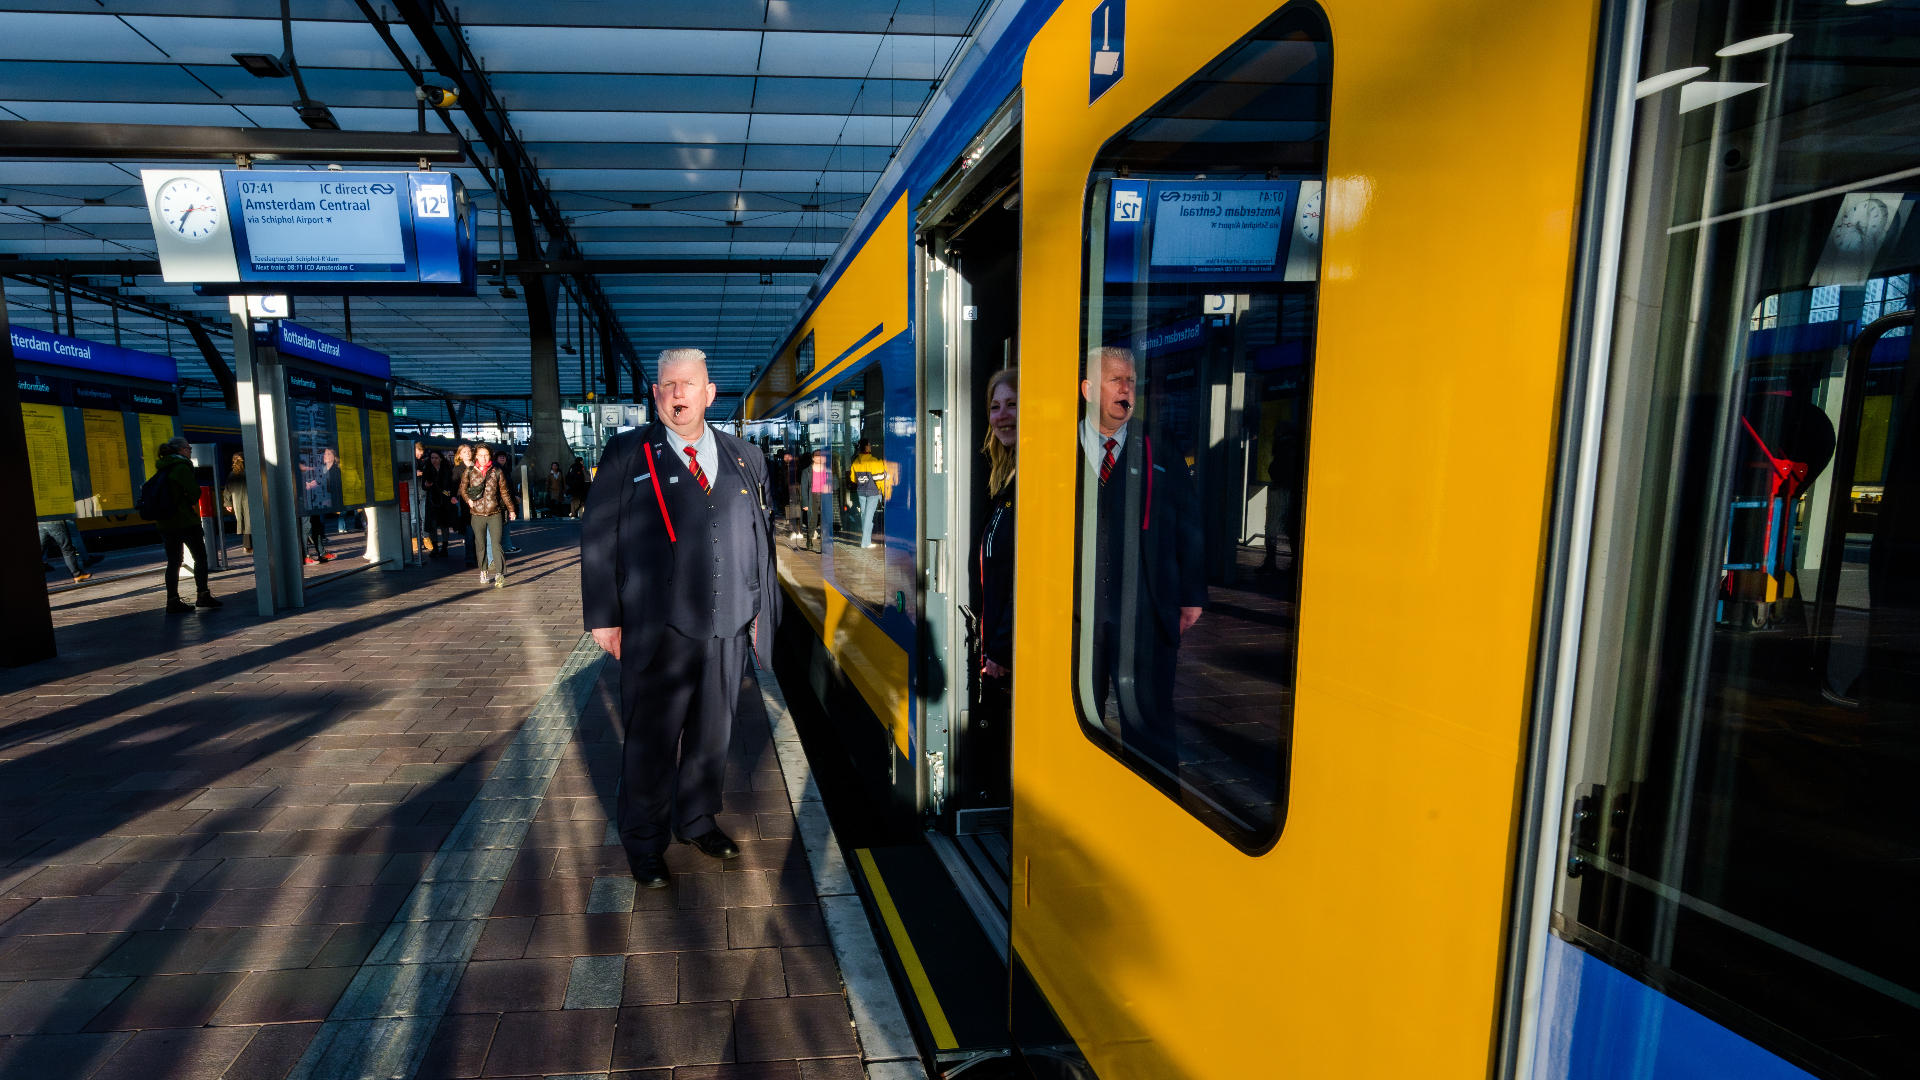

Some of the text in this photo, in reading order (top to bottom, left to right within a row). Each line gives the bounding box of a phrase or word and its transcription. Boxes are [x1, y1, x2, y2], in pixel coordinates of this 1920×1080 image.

[242, 182, 274, 194] 07:41
[320, 182, 368, 195] IC direct
[245, 198, 371, 211] Amsterdam Centraal
[247, 215, 324, 226] via Schiphol Airport
[260, 295, 276, 314] C
[10, 332, 92, 360] tterdam Centraal
[283, 327, 341, 357] Rotterdam Centraal
[17, 380, 50, 393] informatie
